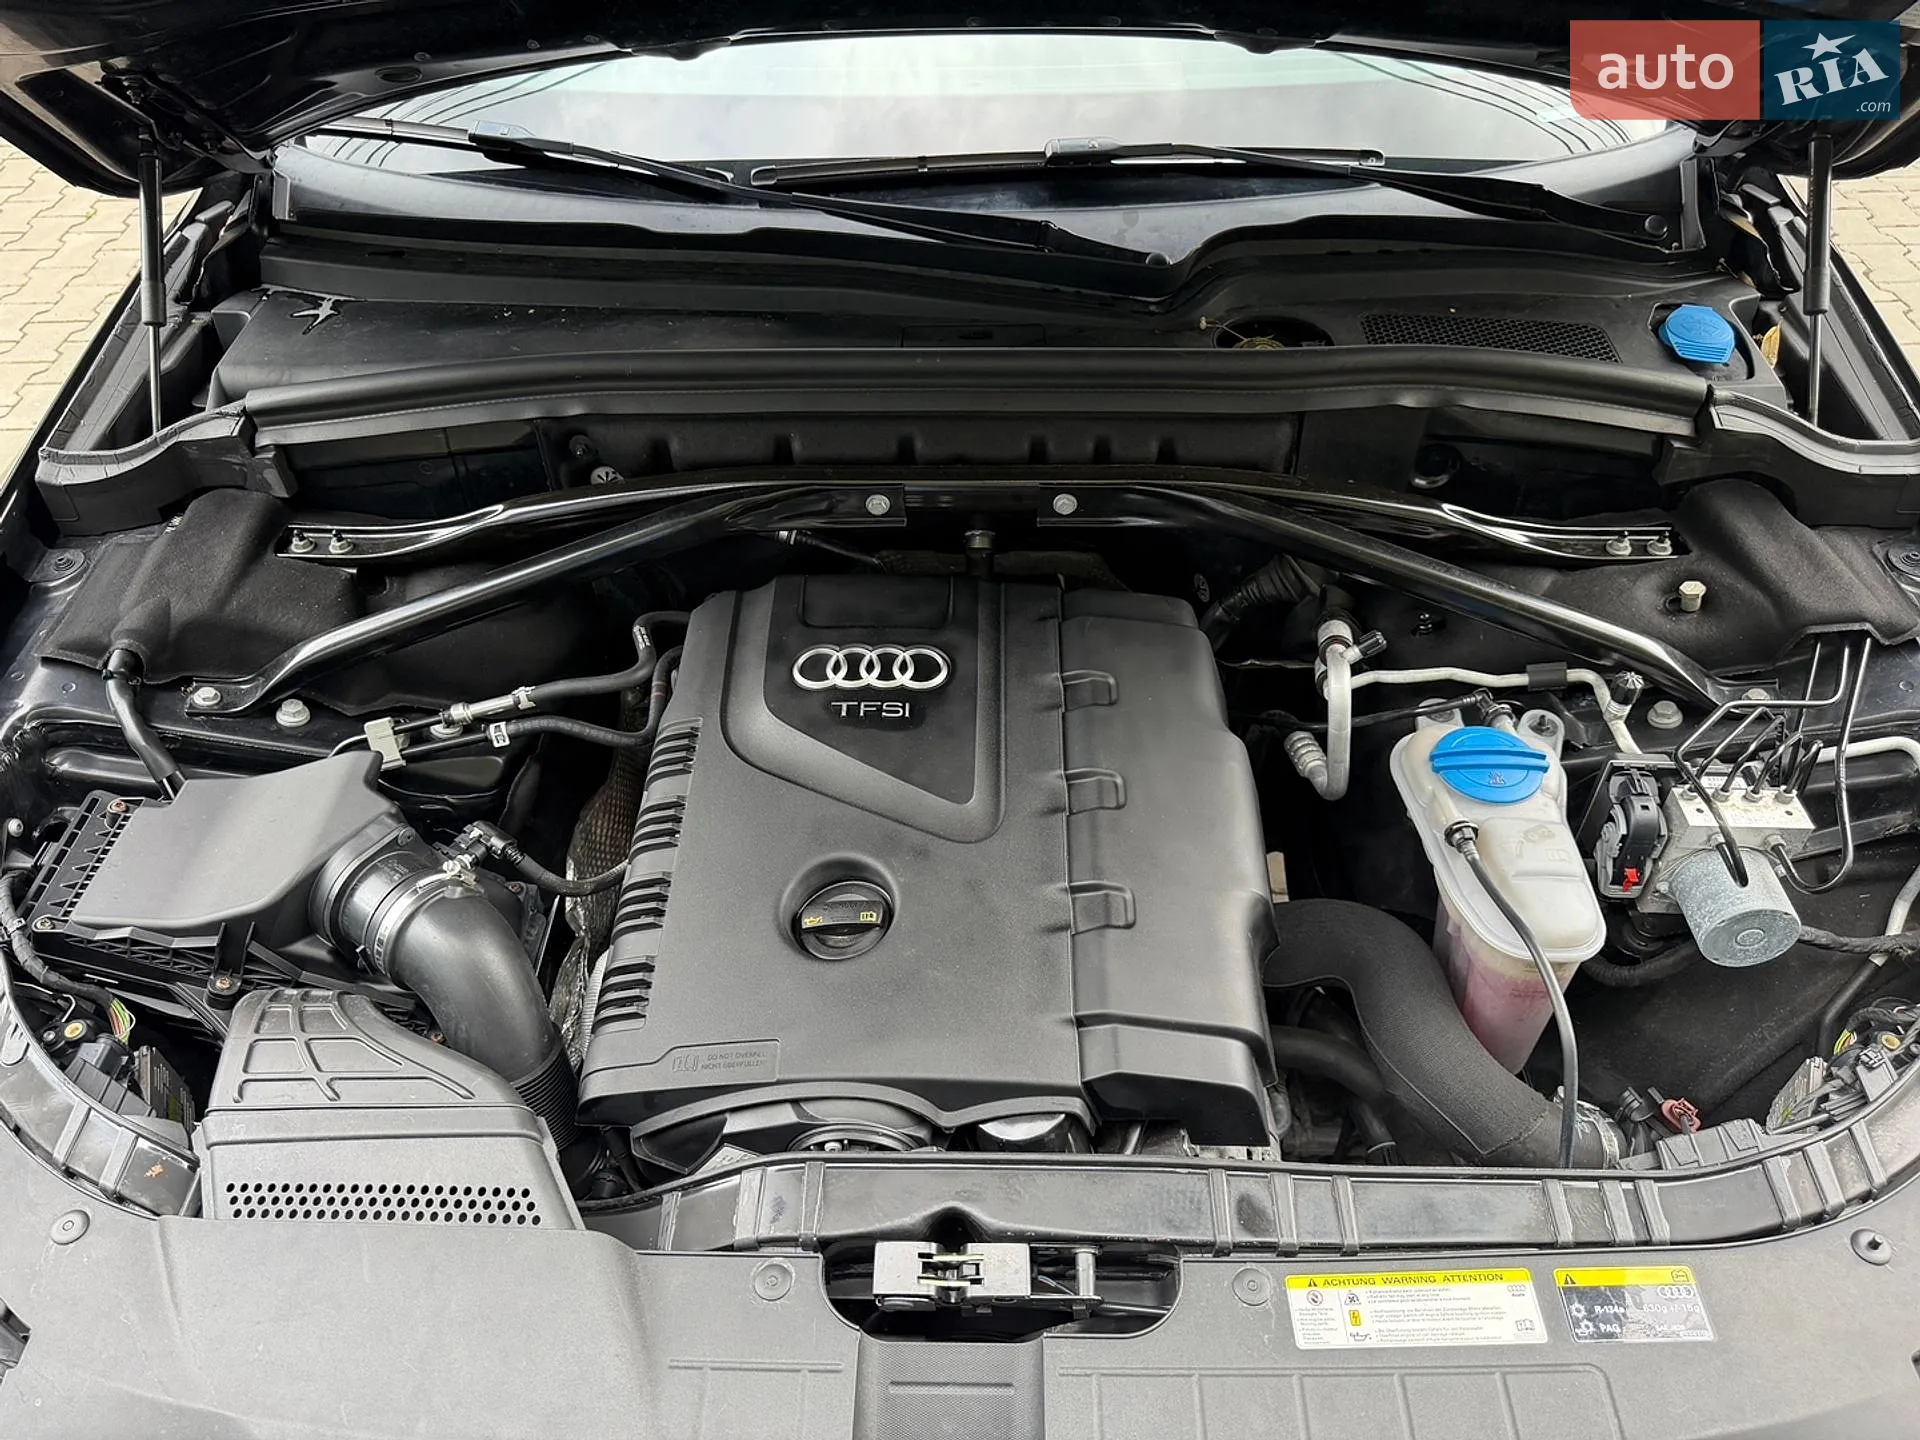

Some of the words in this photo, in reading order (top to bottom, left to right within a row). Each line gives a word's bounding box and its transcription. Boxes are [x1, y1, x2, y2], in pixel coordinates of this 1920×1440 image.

[831, 701, 911, 718] TFSI
[1322, 1277, 1376, 1288] ACHTUNG
[1381, 1275, 1437, 1286] WARNING
[1442, 1273, 1504, 1283] ATTENTION
